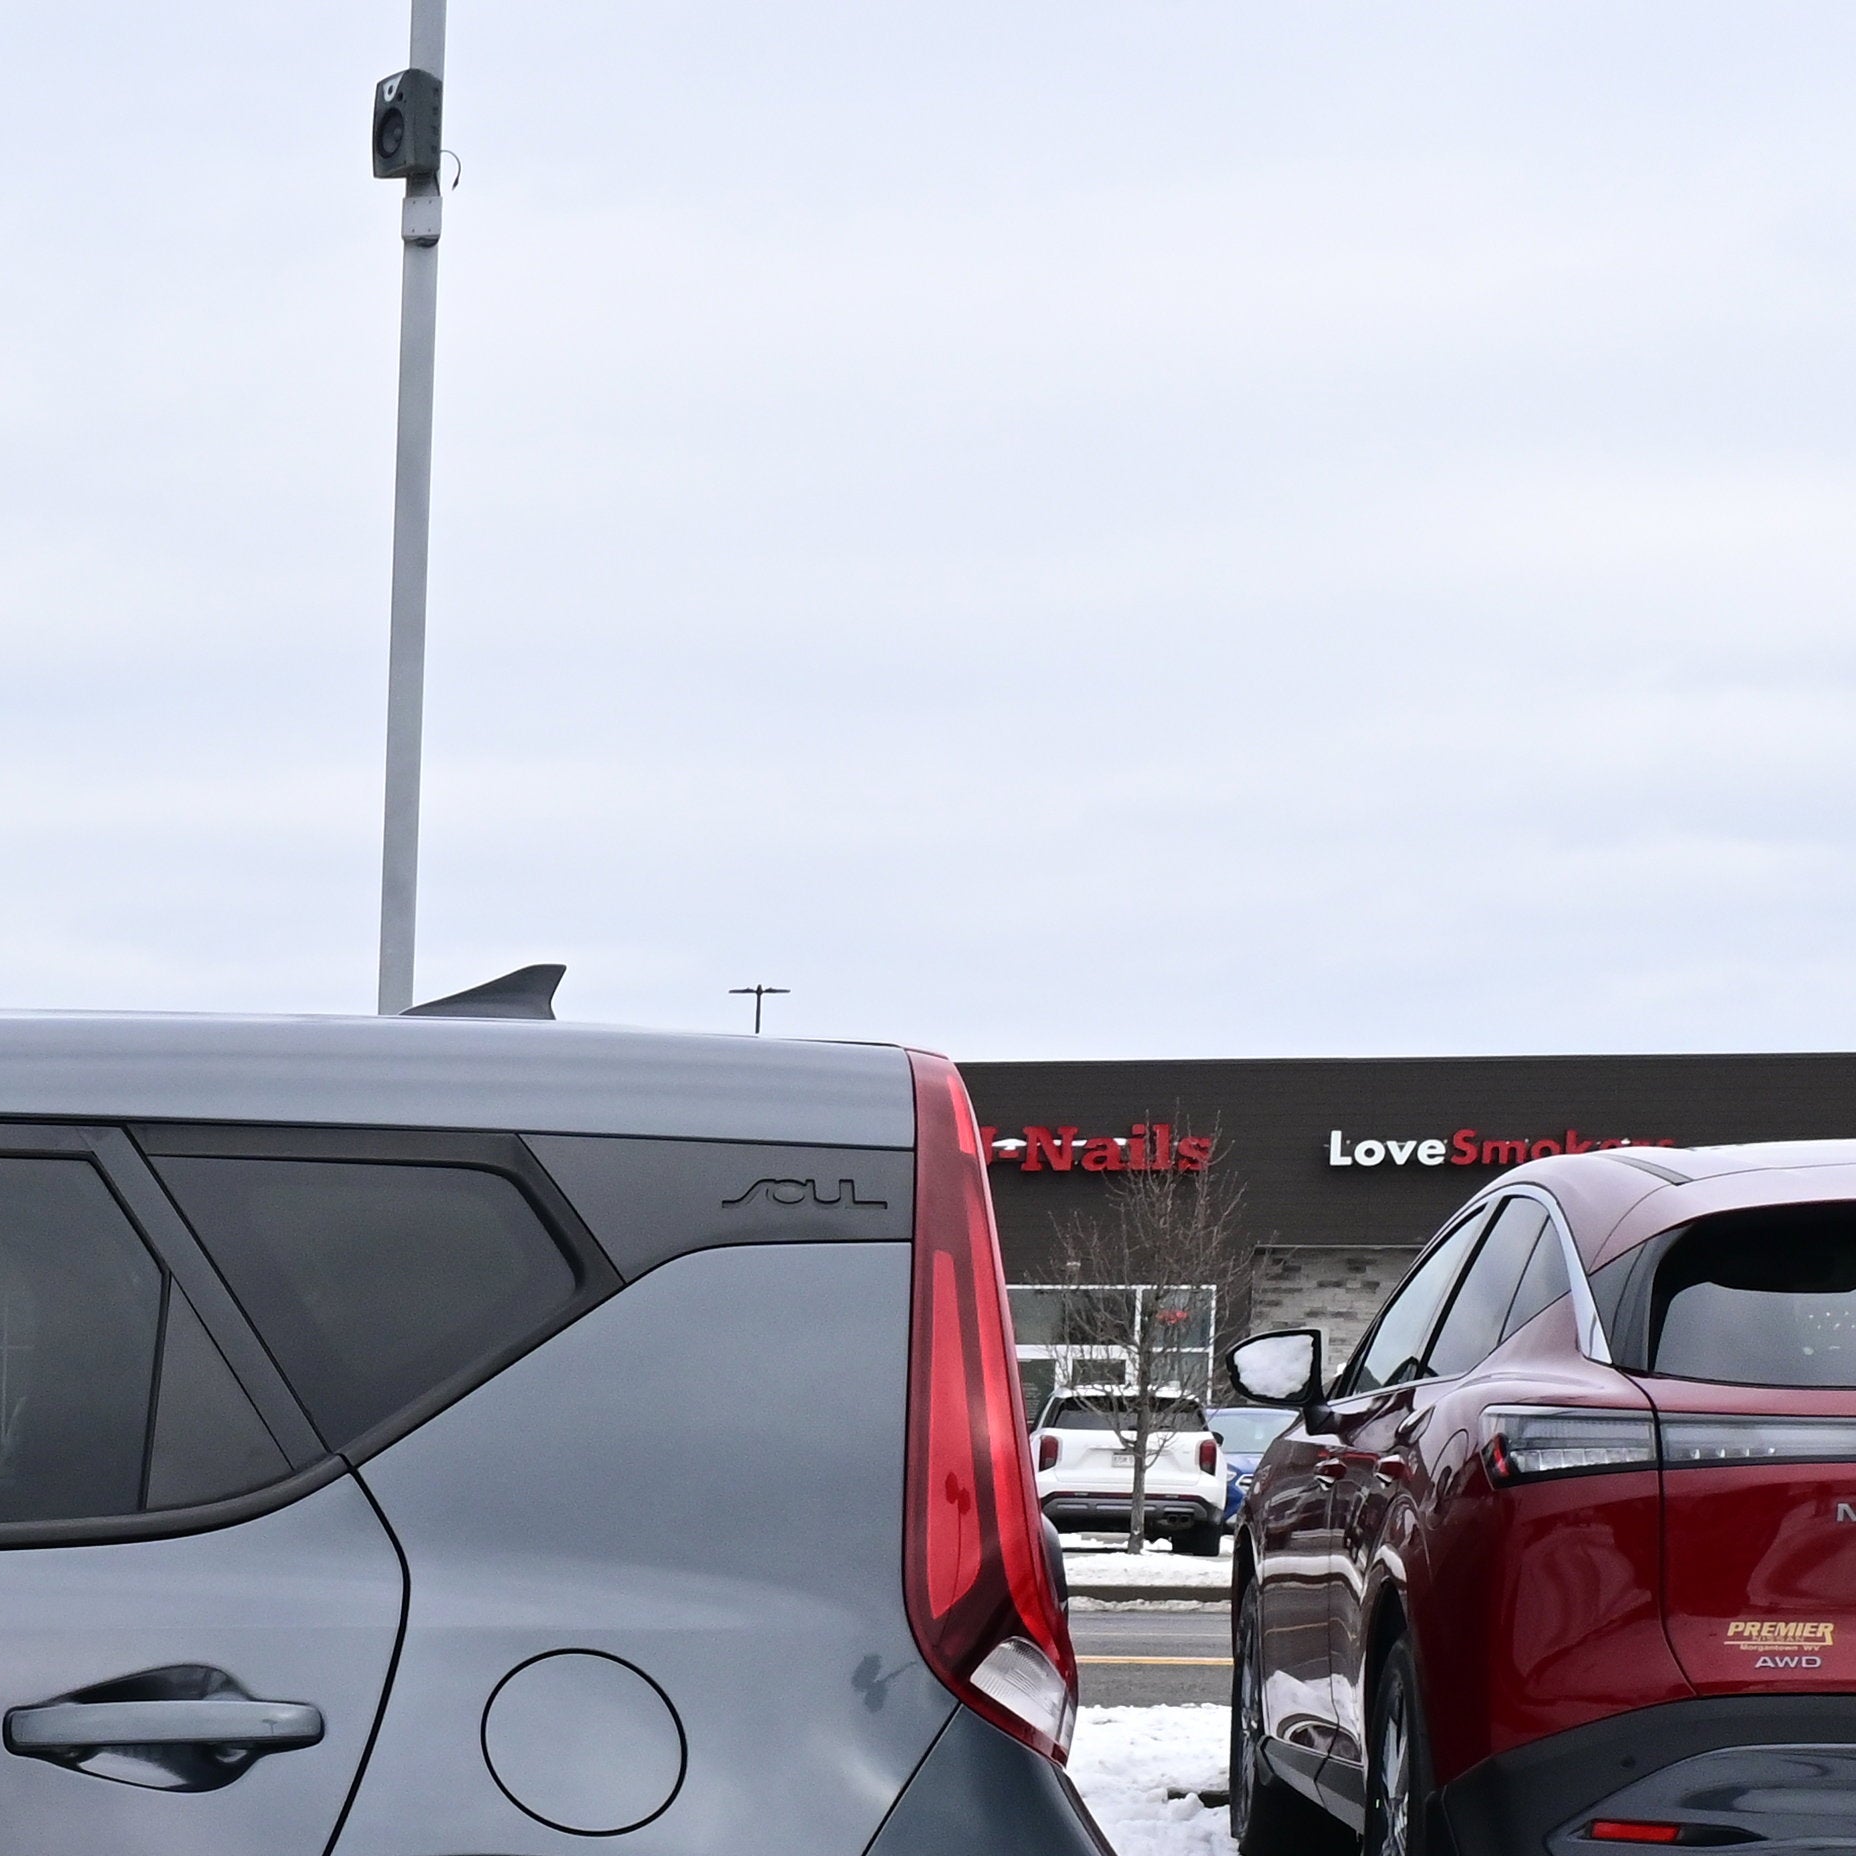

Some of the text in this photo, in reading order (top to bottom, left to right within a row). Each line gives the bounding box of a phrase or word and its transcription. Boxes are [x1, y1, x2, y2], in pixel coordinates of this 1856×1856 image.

[981, 1123, 1213, 1172] -Nails
[1727, 1622, 1834, 1638] PREMIER
[1740, 1643, 1798, 1651] Morgantown
[1754, 1656, 1821, 1668] AWD
